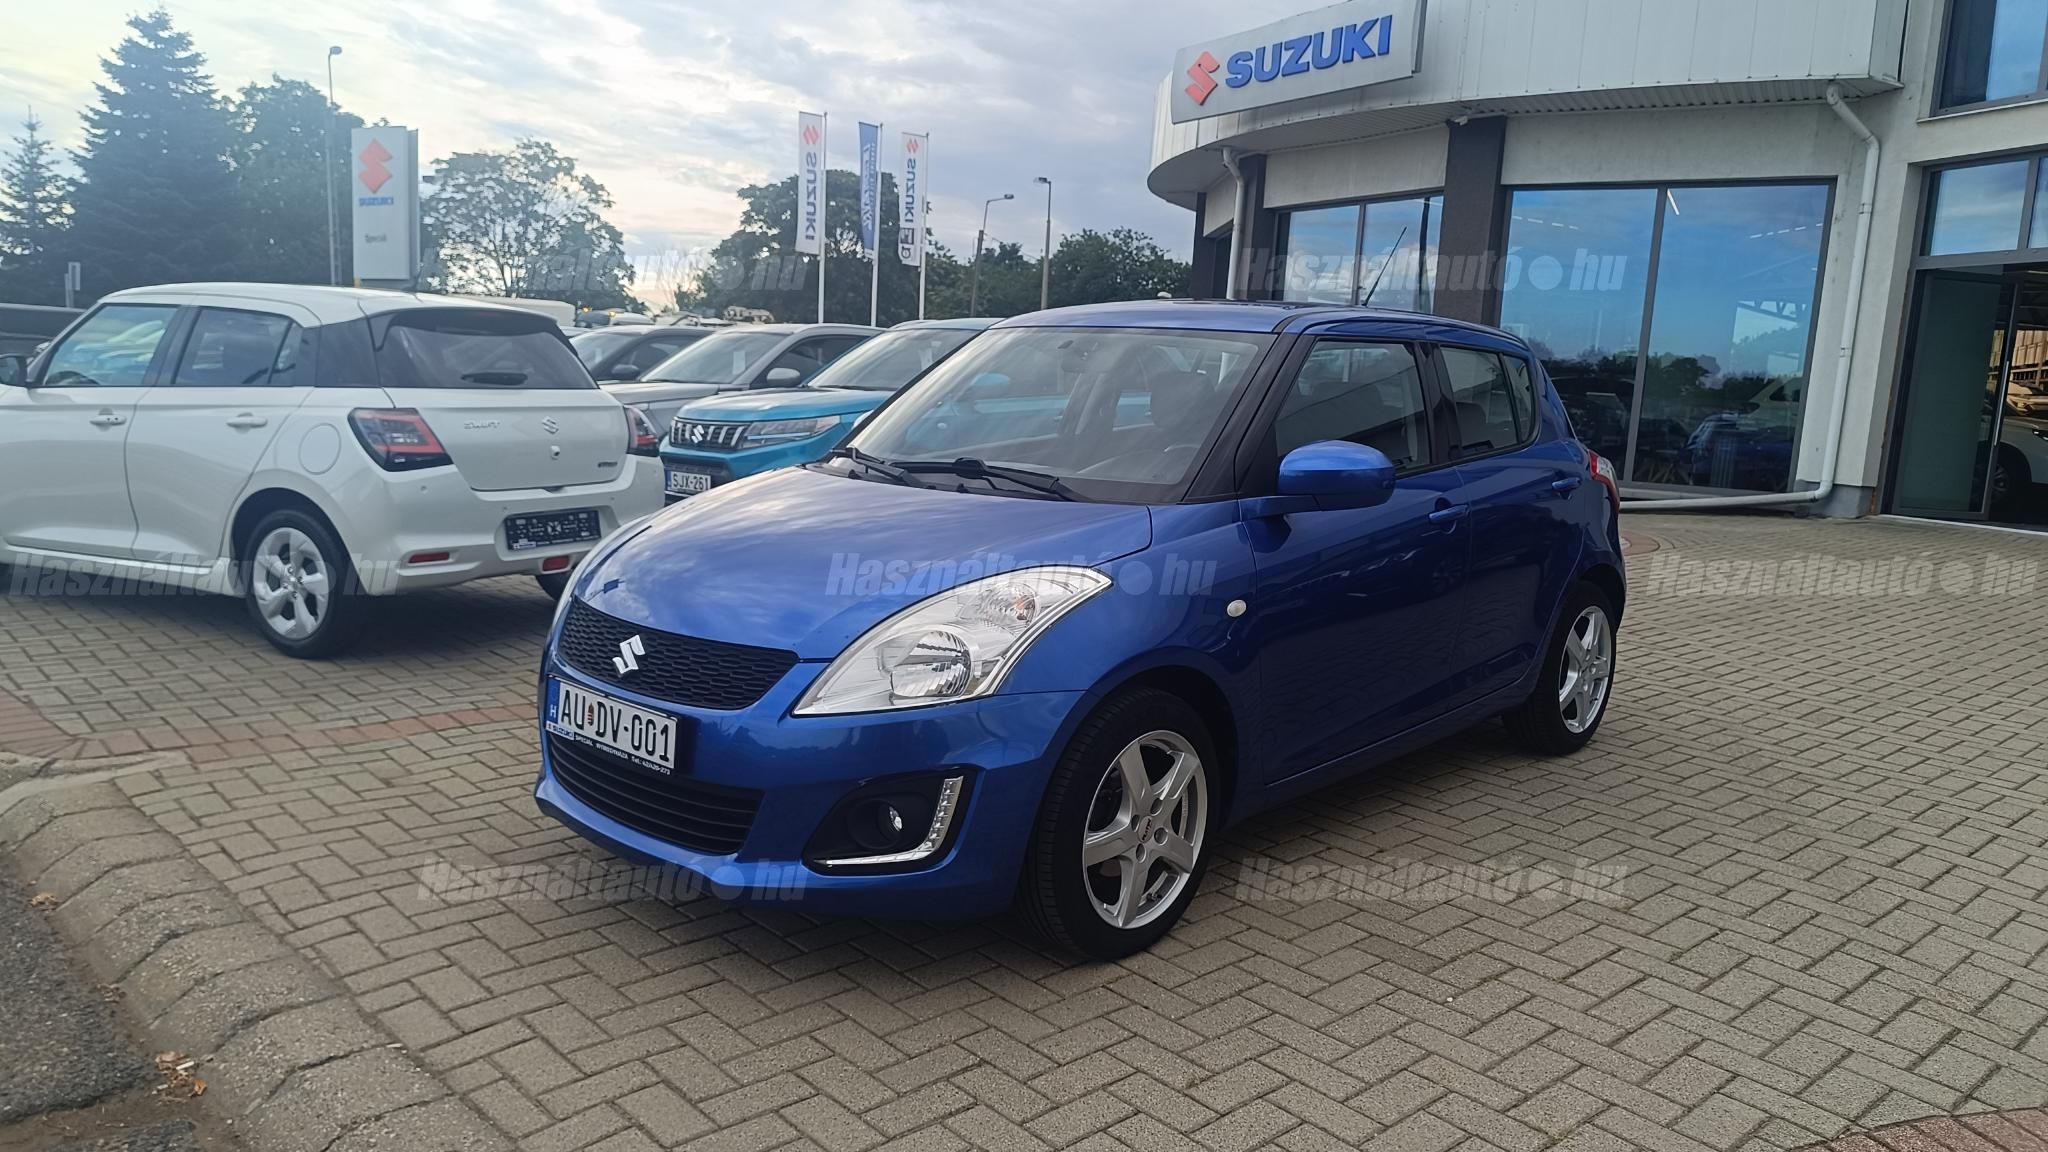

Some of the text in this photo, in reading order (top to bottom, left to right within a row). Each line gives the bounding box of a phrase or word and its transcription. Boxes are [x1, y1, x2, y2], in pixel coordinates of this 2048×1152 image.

[1225, 14, 1393, 89] SUZUKI
[673, 473, 709, 491] SJX-261
[550, 704, 557, 717] H
